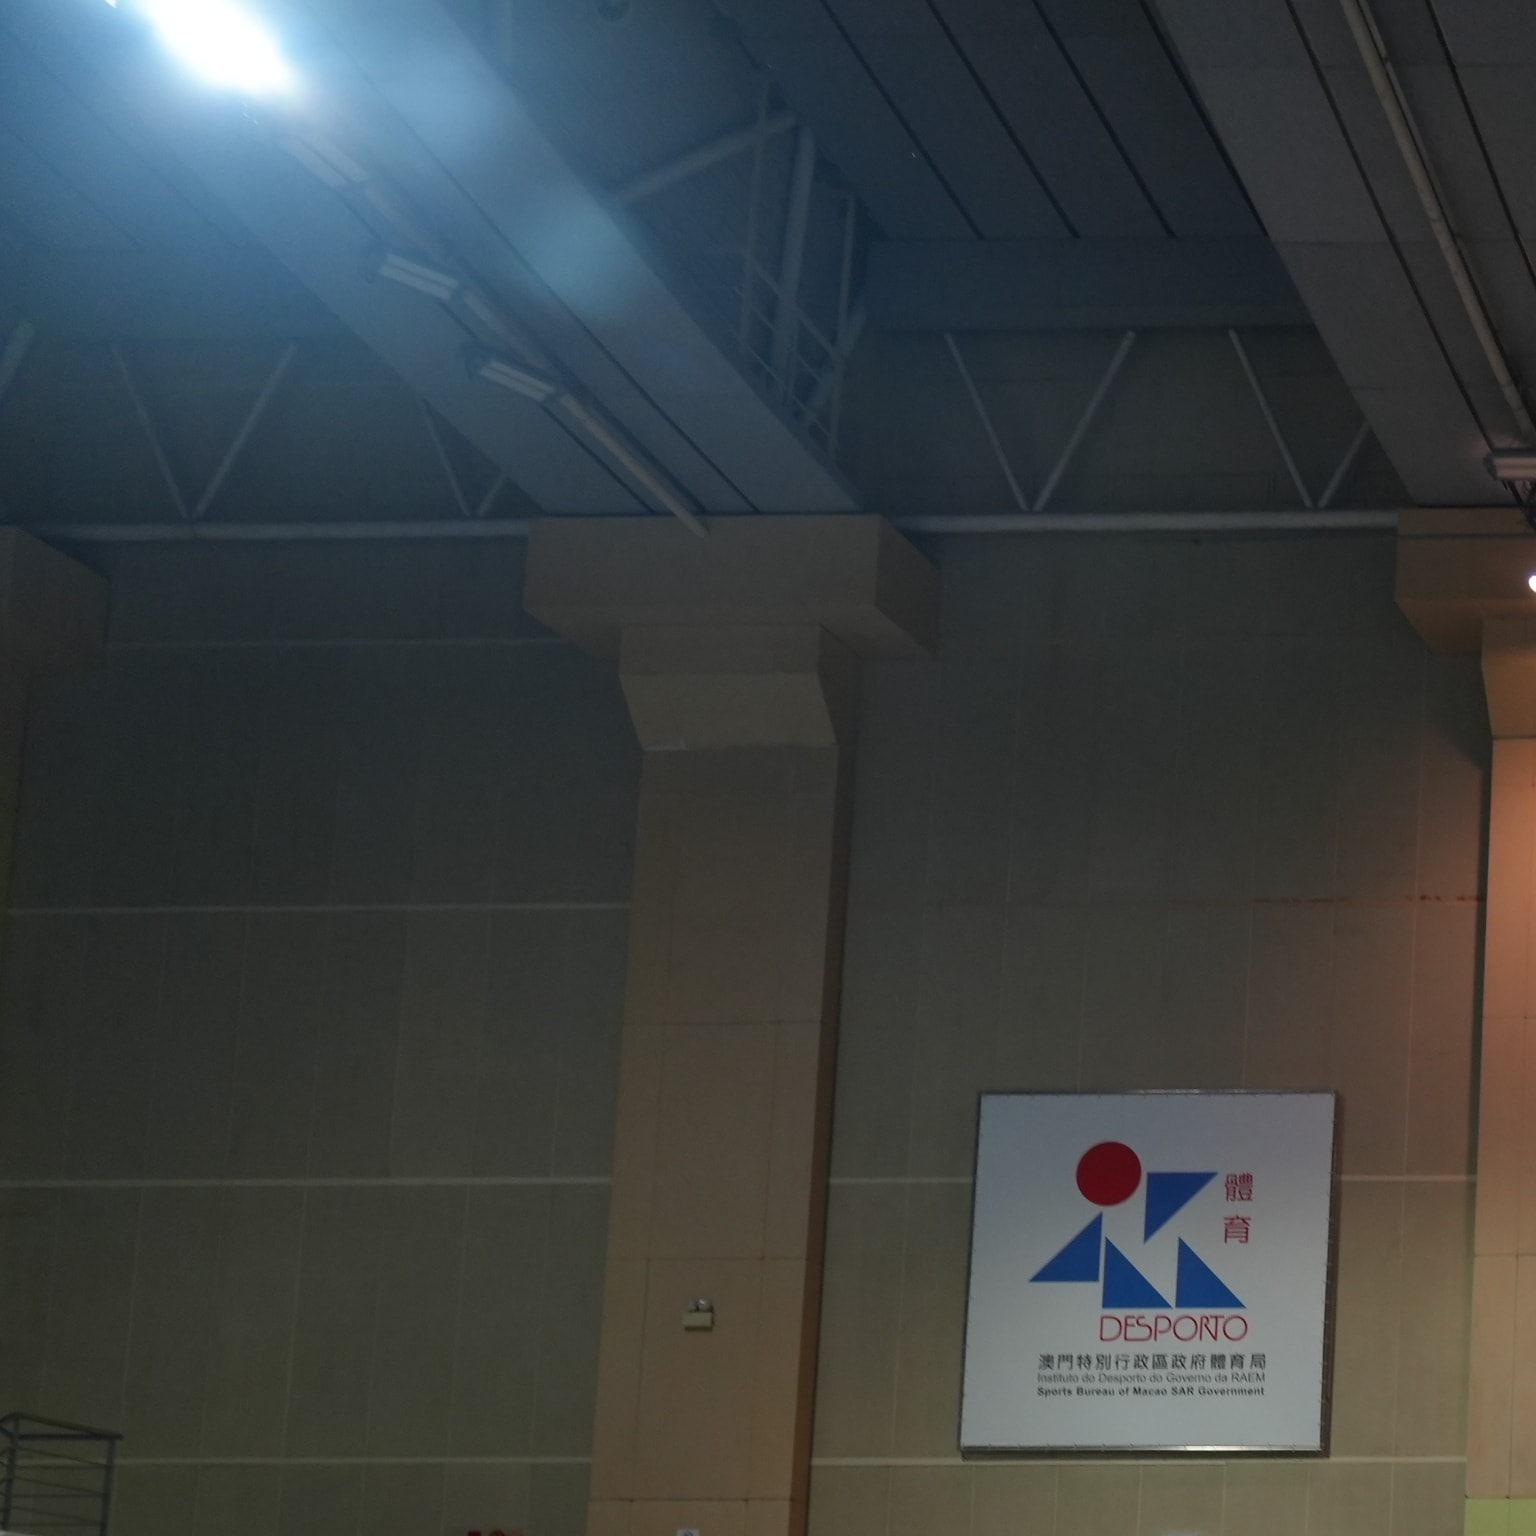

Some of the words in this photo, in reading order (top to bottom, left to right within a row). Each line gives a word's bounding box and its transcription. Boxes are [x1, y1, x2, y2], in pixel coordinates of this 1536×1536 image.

[1224, 1173, 1253, 1244] 體育
[1100, 1315, 1248, 1342] DESPORTO
[1038, 1353, 1266, 1370] 澳門特別行政區政府體育局
[1037, 1373, 1079, 1384] Instituto
[1081, 1373, 1095, 1384] do
[1099, 1373, 1147, 1386] Desporto
[1149, 1373, 1163, 1384] do
[1166, 1373, 1211, 1384] Governo
[1214, 1373, 1228, 1384] da
[1231, 1373, 1266, 1384] RAEM
[1037, 1386, 1072, 1398] Sports
[1076, 1386, 1115, 1397] Bureau
[1118, 1386, 1130, 1397] of
[1133, 1386, 1168, 1397] Macao
[1171, 1386, 1195, 1397] SAR
[1198, 1386, 1265, 1397] Government
